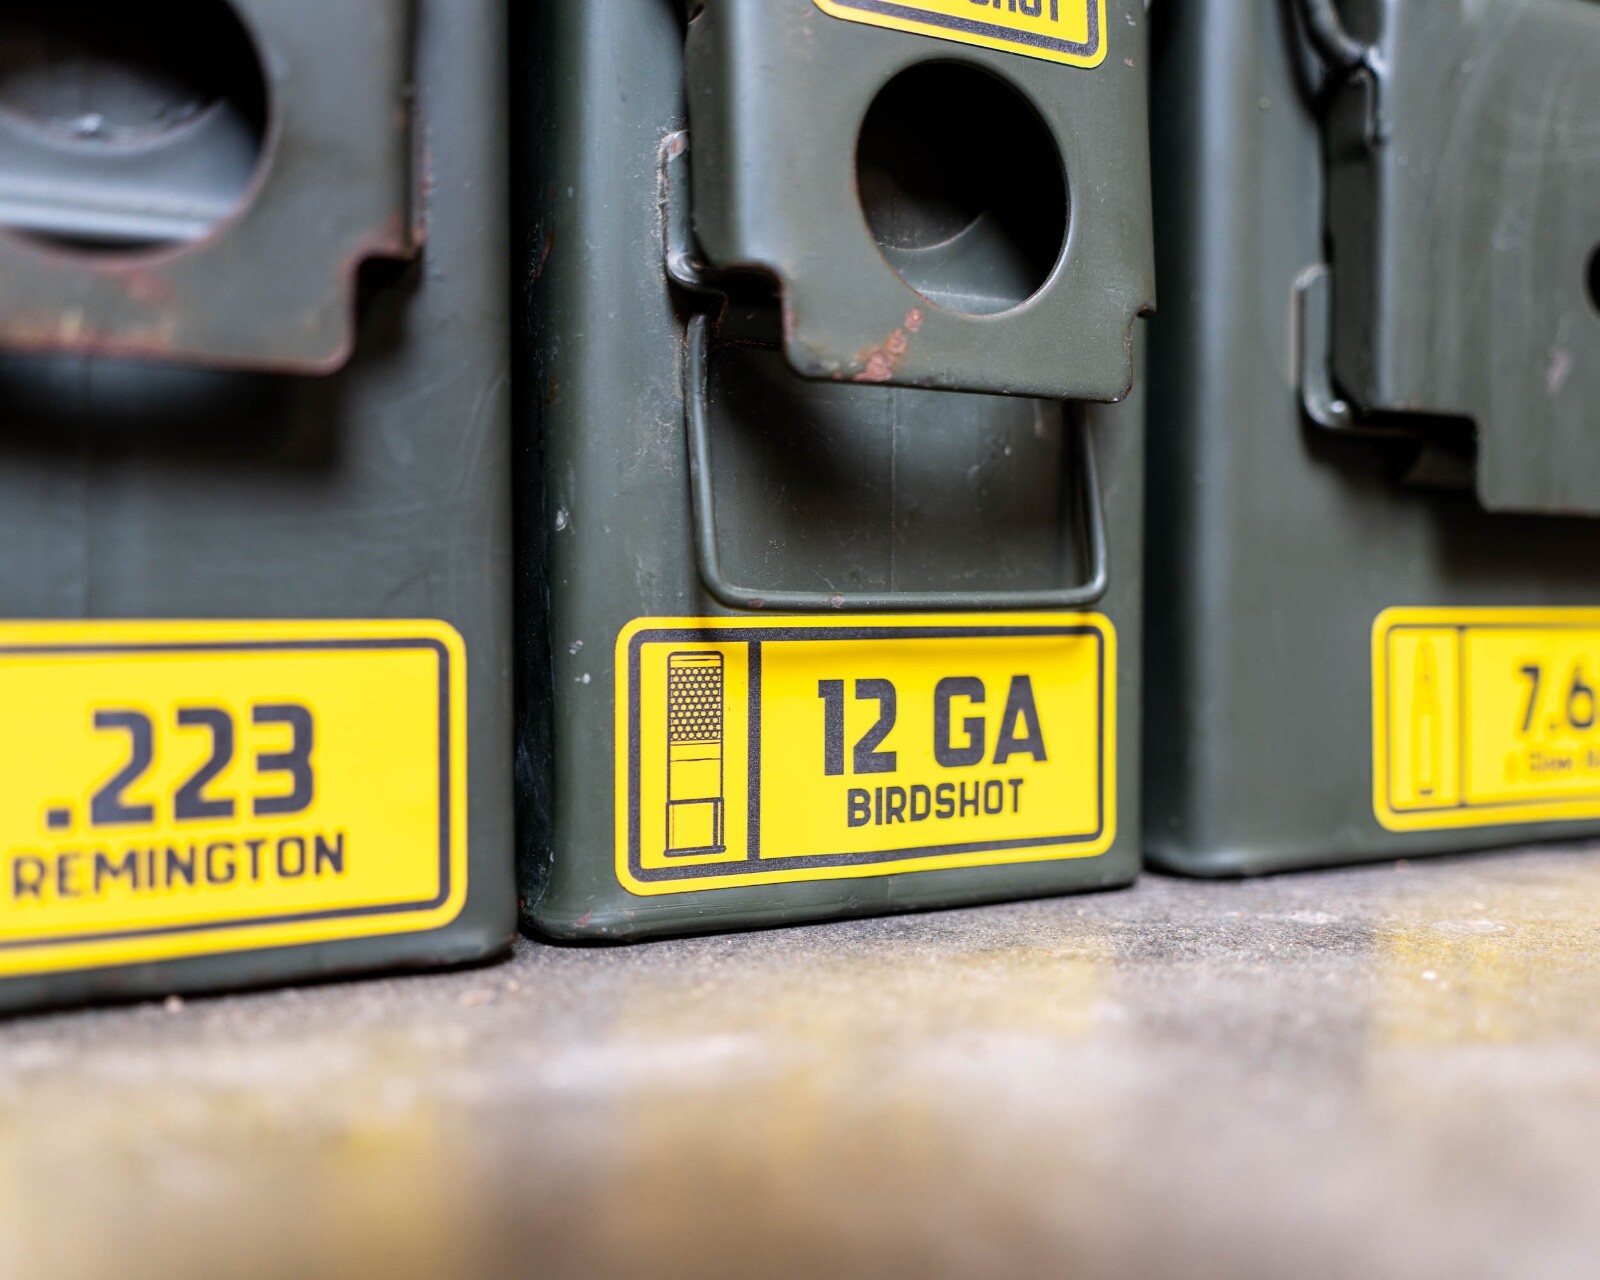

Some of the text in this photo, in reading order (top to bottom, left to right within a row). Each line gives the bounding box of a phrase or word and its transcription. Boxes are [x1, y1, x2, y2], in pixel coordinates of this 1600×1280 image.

[818, 674, 1048, 776] 12 GA
[1520, 664, 1600, 733] 7.6
[46, 703, 314, 828] .223
[847, 778, 1024, 828] BIRDSHOT
[12, 832, 345, 899] REMINGTON
